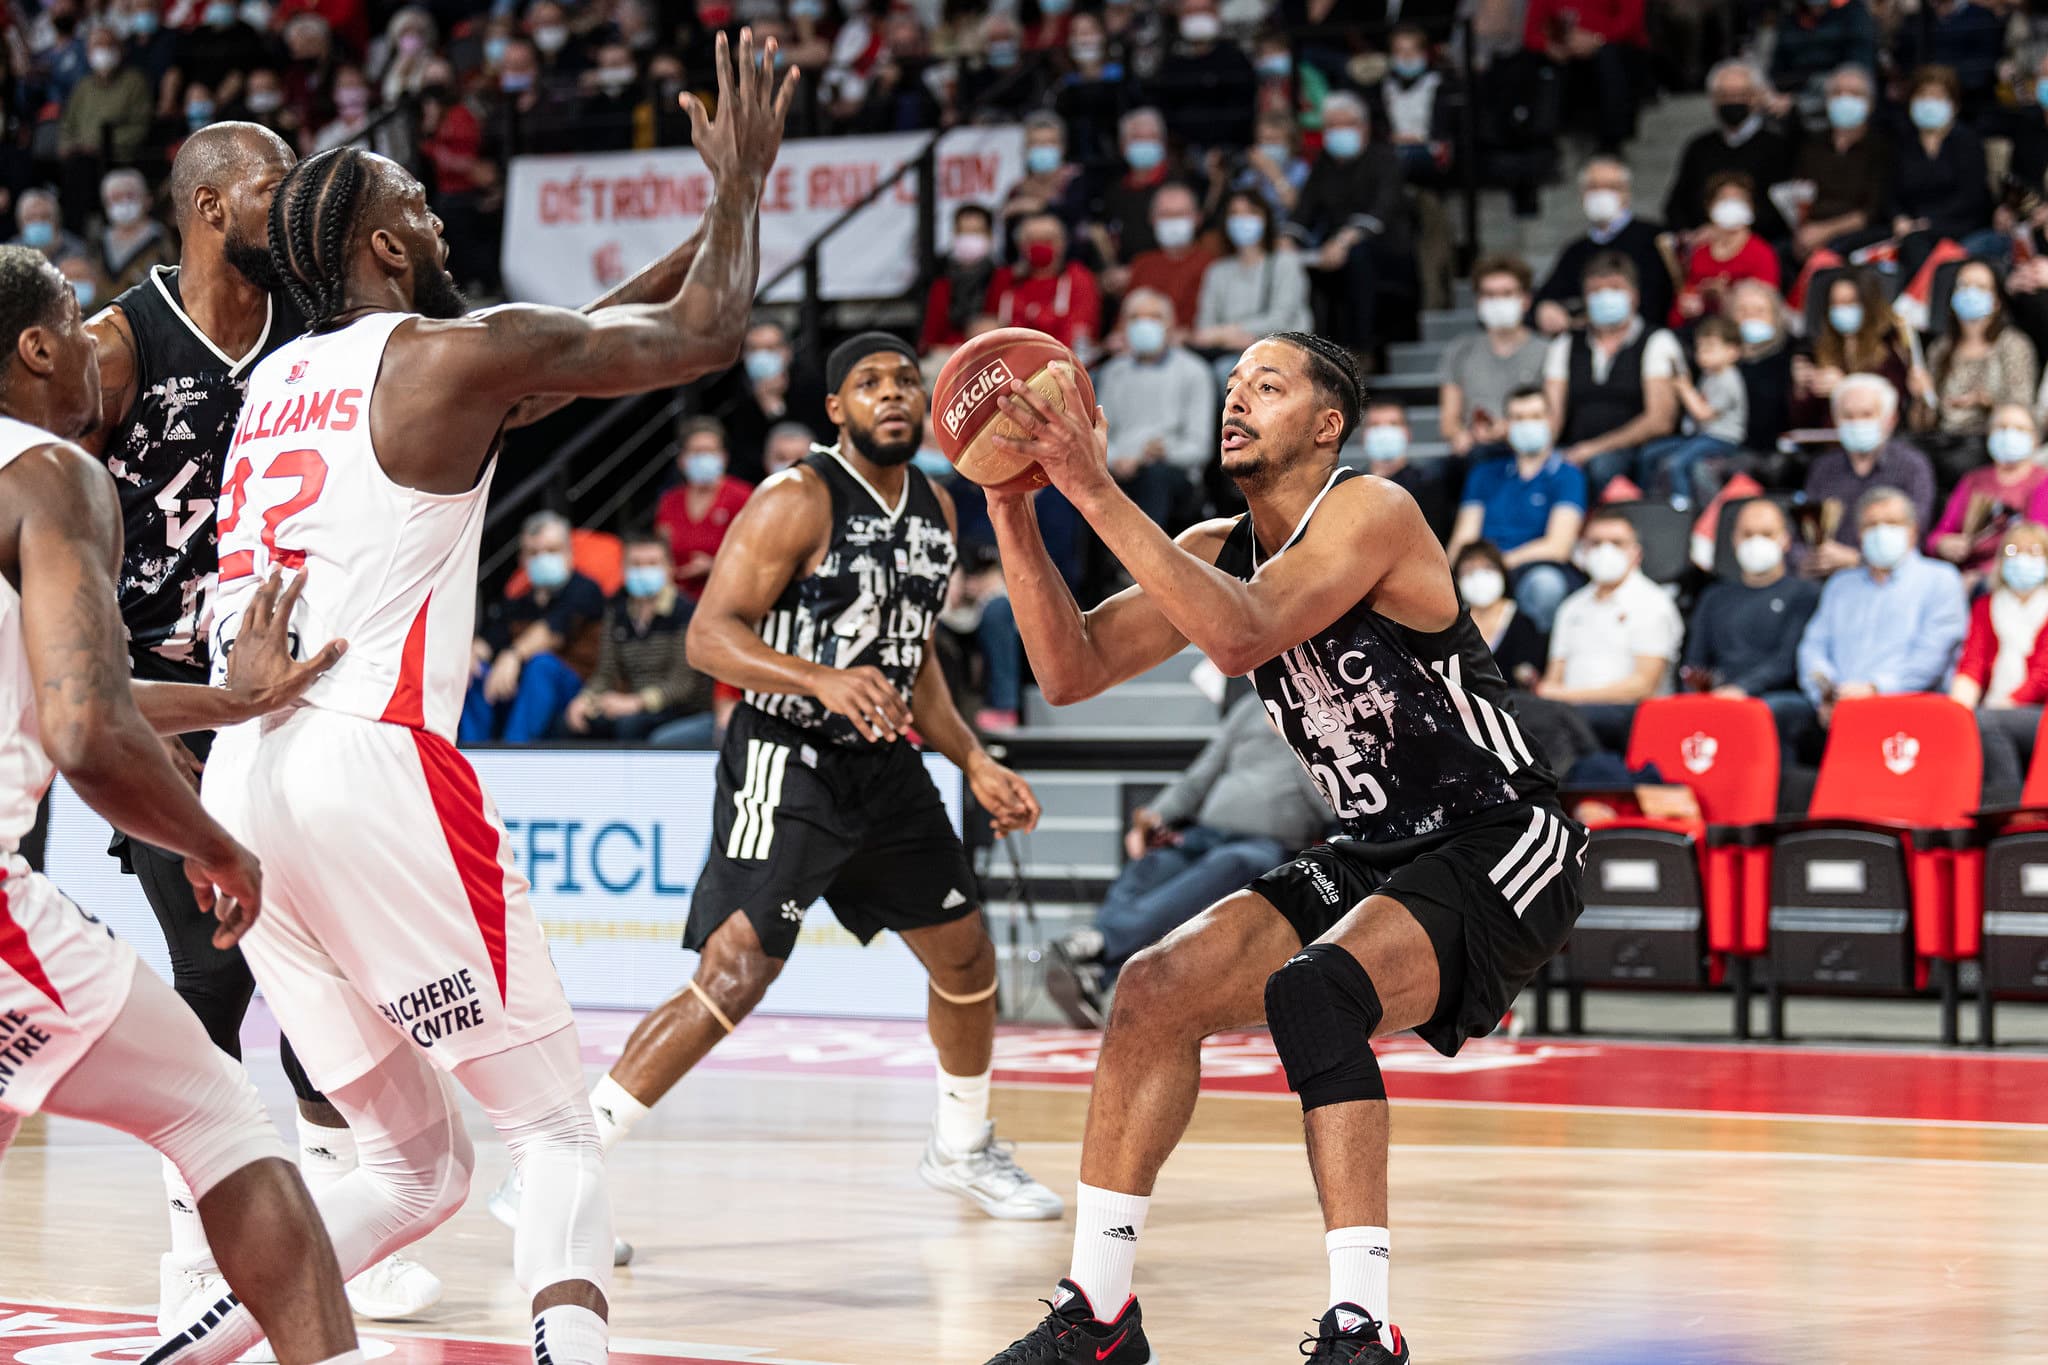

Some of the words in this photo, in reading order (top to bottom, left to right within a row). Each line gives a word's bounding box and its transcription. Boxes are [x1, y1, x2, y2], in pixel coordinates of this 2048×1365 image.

[539, 166, 712, 226] DÉTRÔNE
[169, 389, 209, 402] webex
[944, 366, 1006, 434] Betclic
[166, 432, 197, 441] adidas
[1279, 650, 1374, 711] LDLC
[1300, 687, 1396, 740] ASVEL
[1310, 751, 1388, 820] 25
[1312, 871, 1340, 904] dalkia
[1102, 1230, 1138, 1242] adidas
